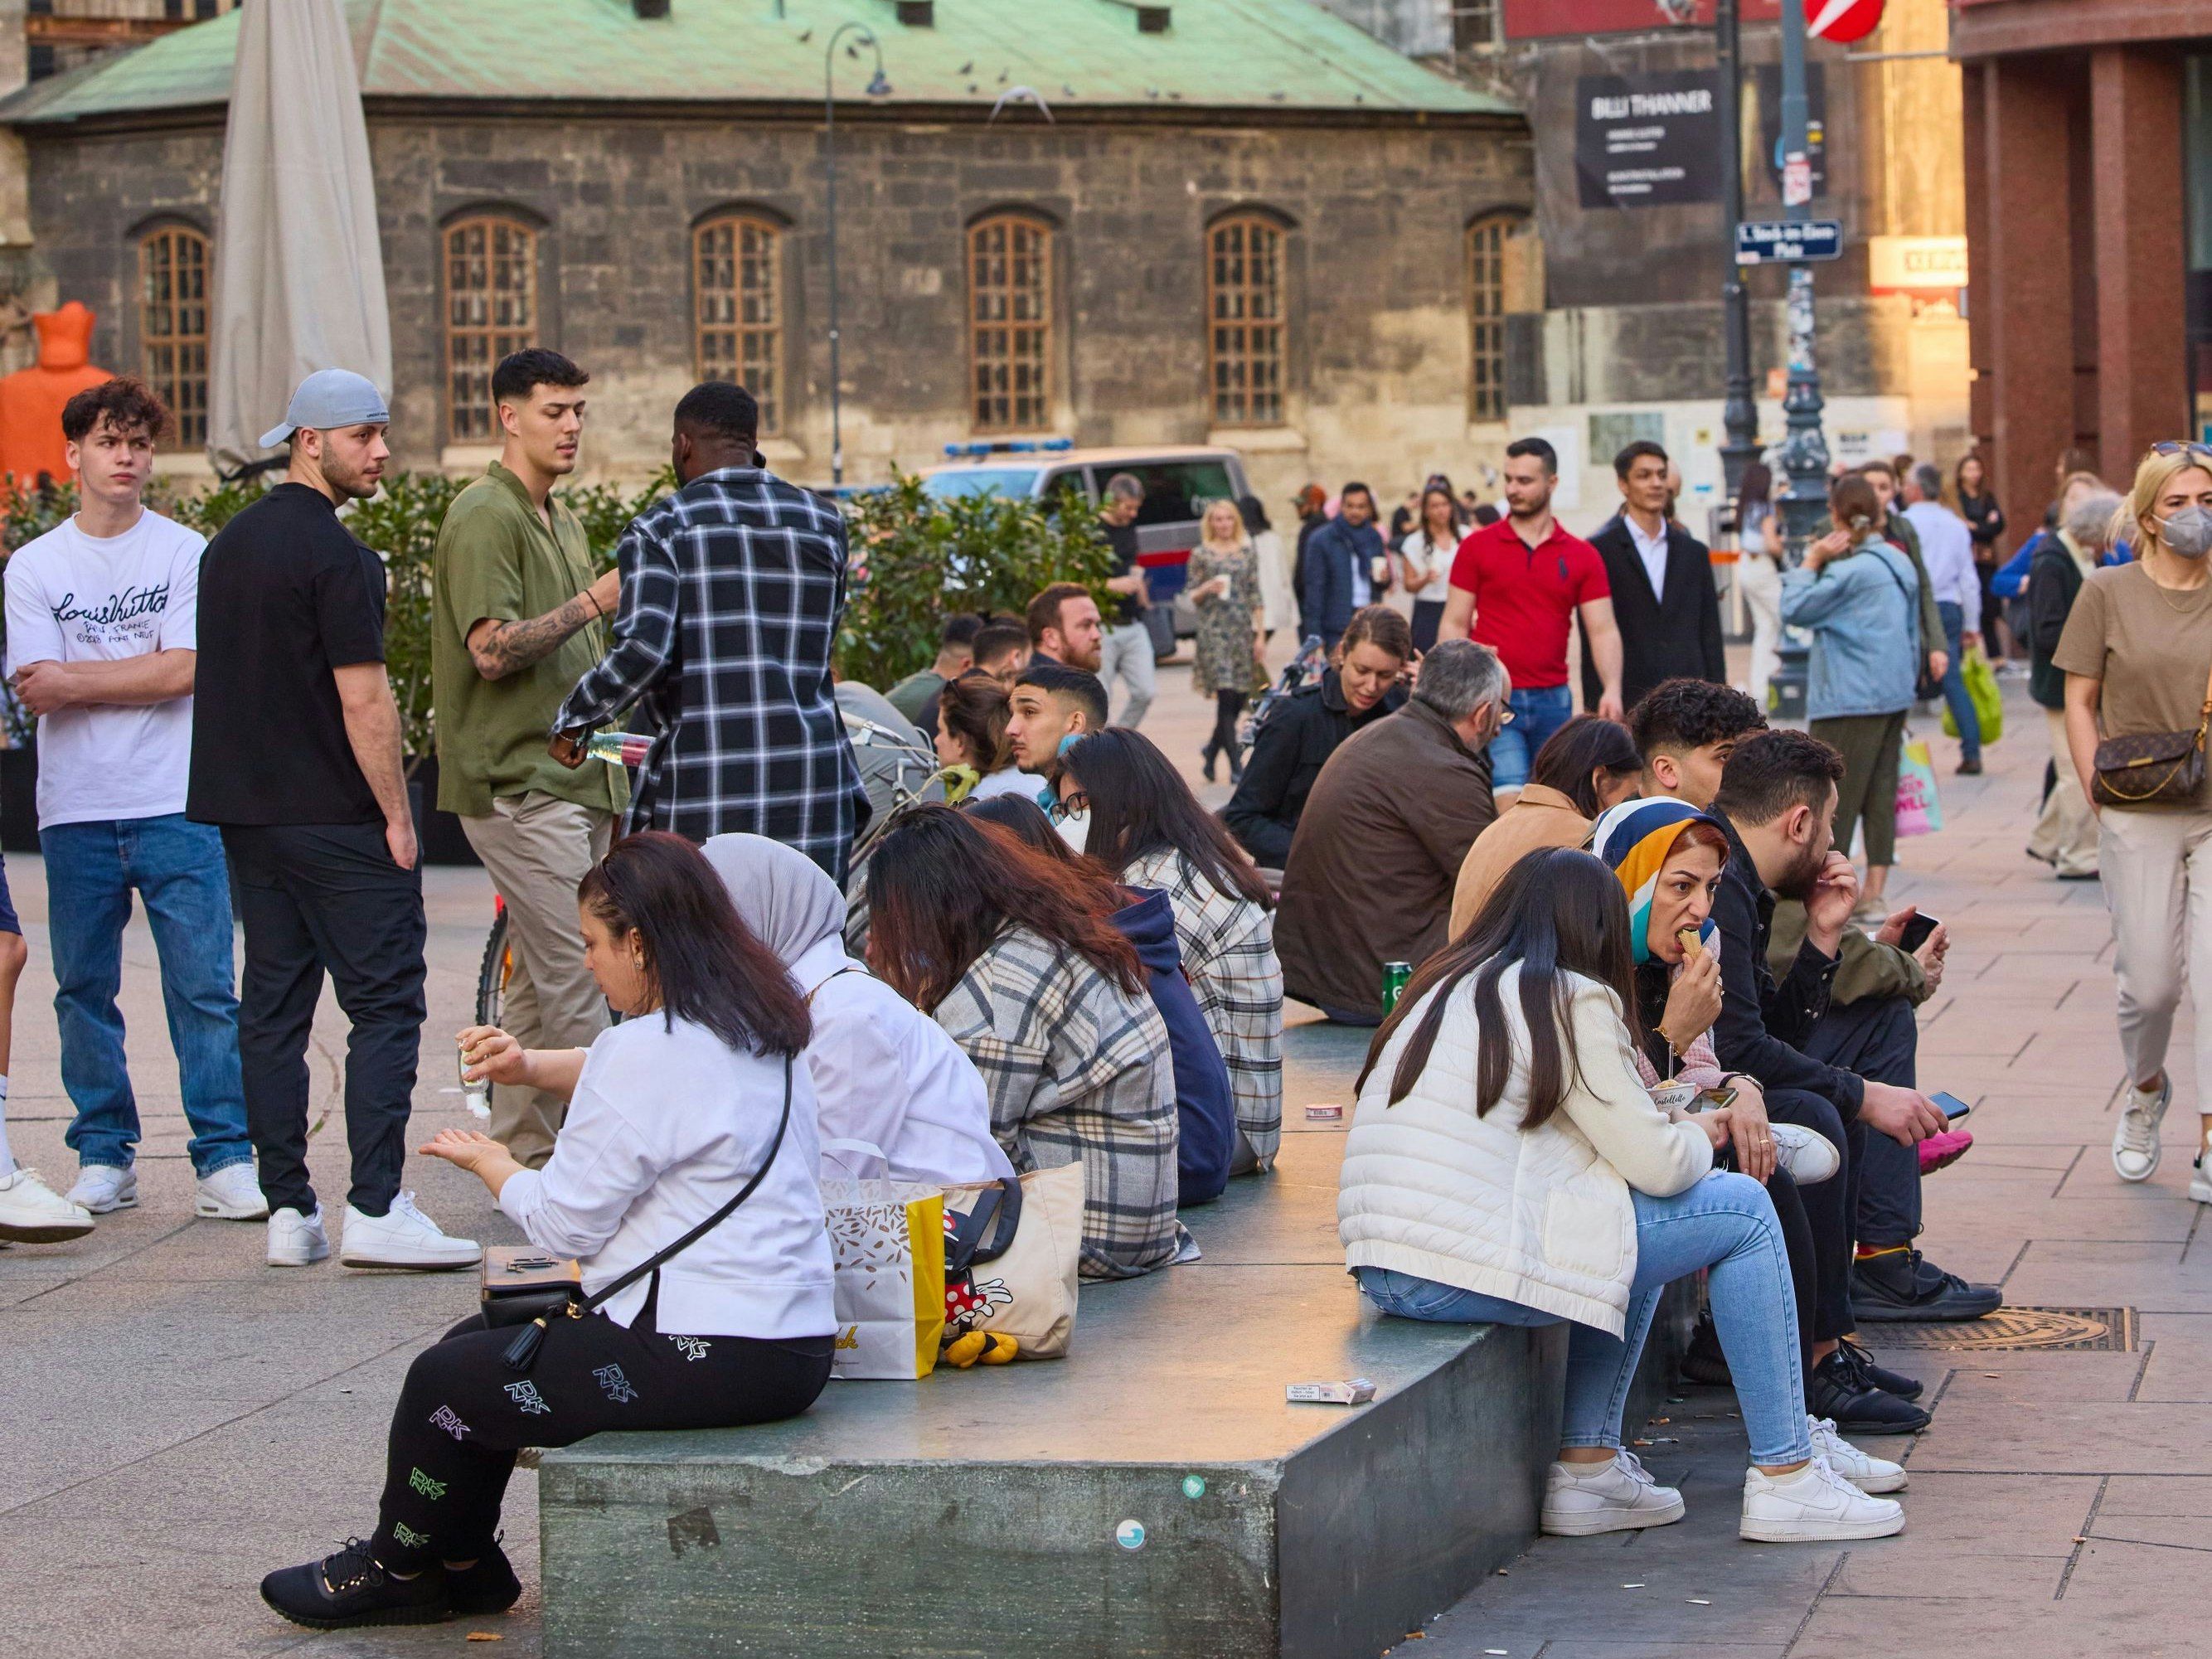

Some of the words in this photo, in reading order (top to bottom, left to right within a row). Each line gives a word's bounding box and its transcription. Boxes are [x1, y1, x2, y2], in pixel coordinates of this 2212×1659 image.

[1630, 89, 1712, 117] THANNER
[51, 593, 109, 624] Louis
[109, 584, 170, 623] Vuitto
